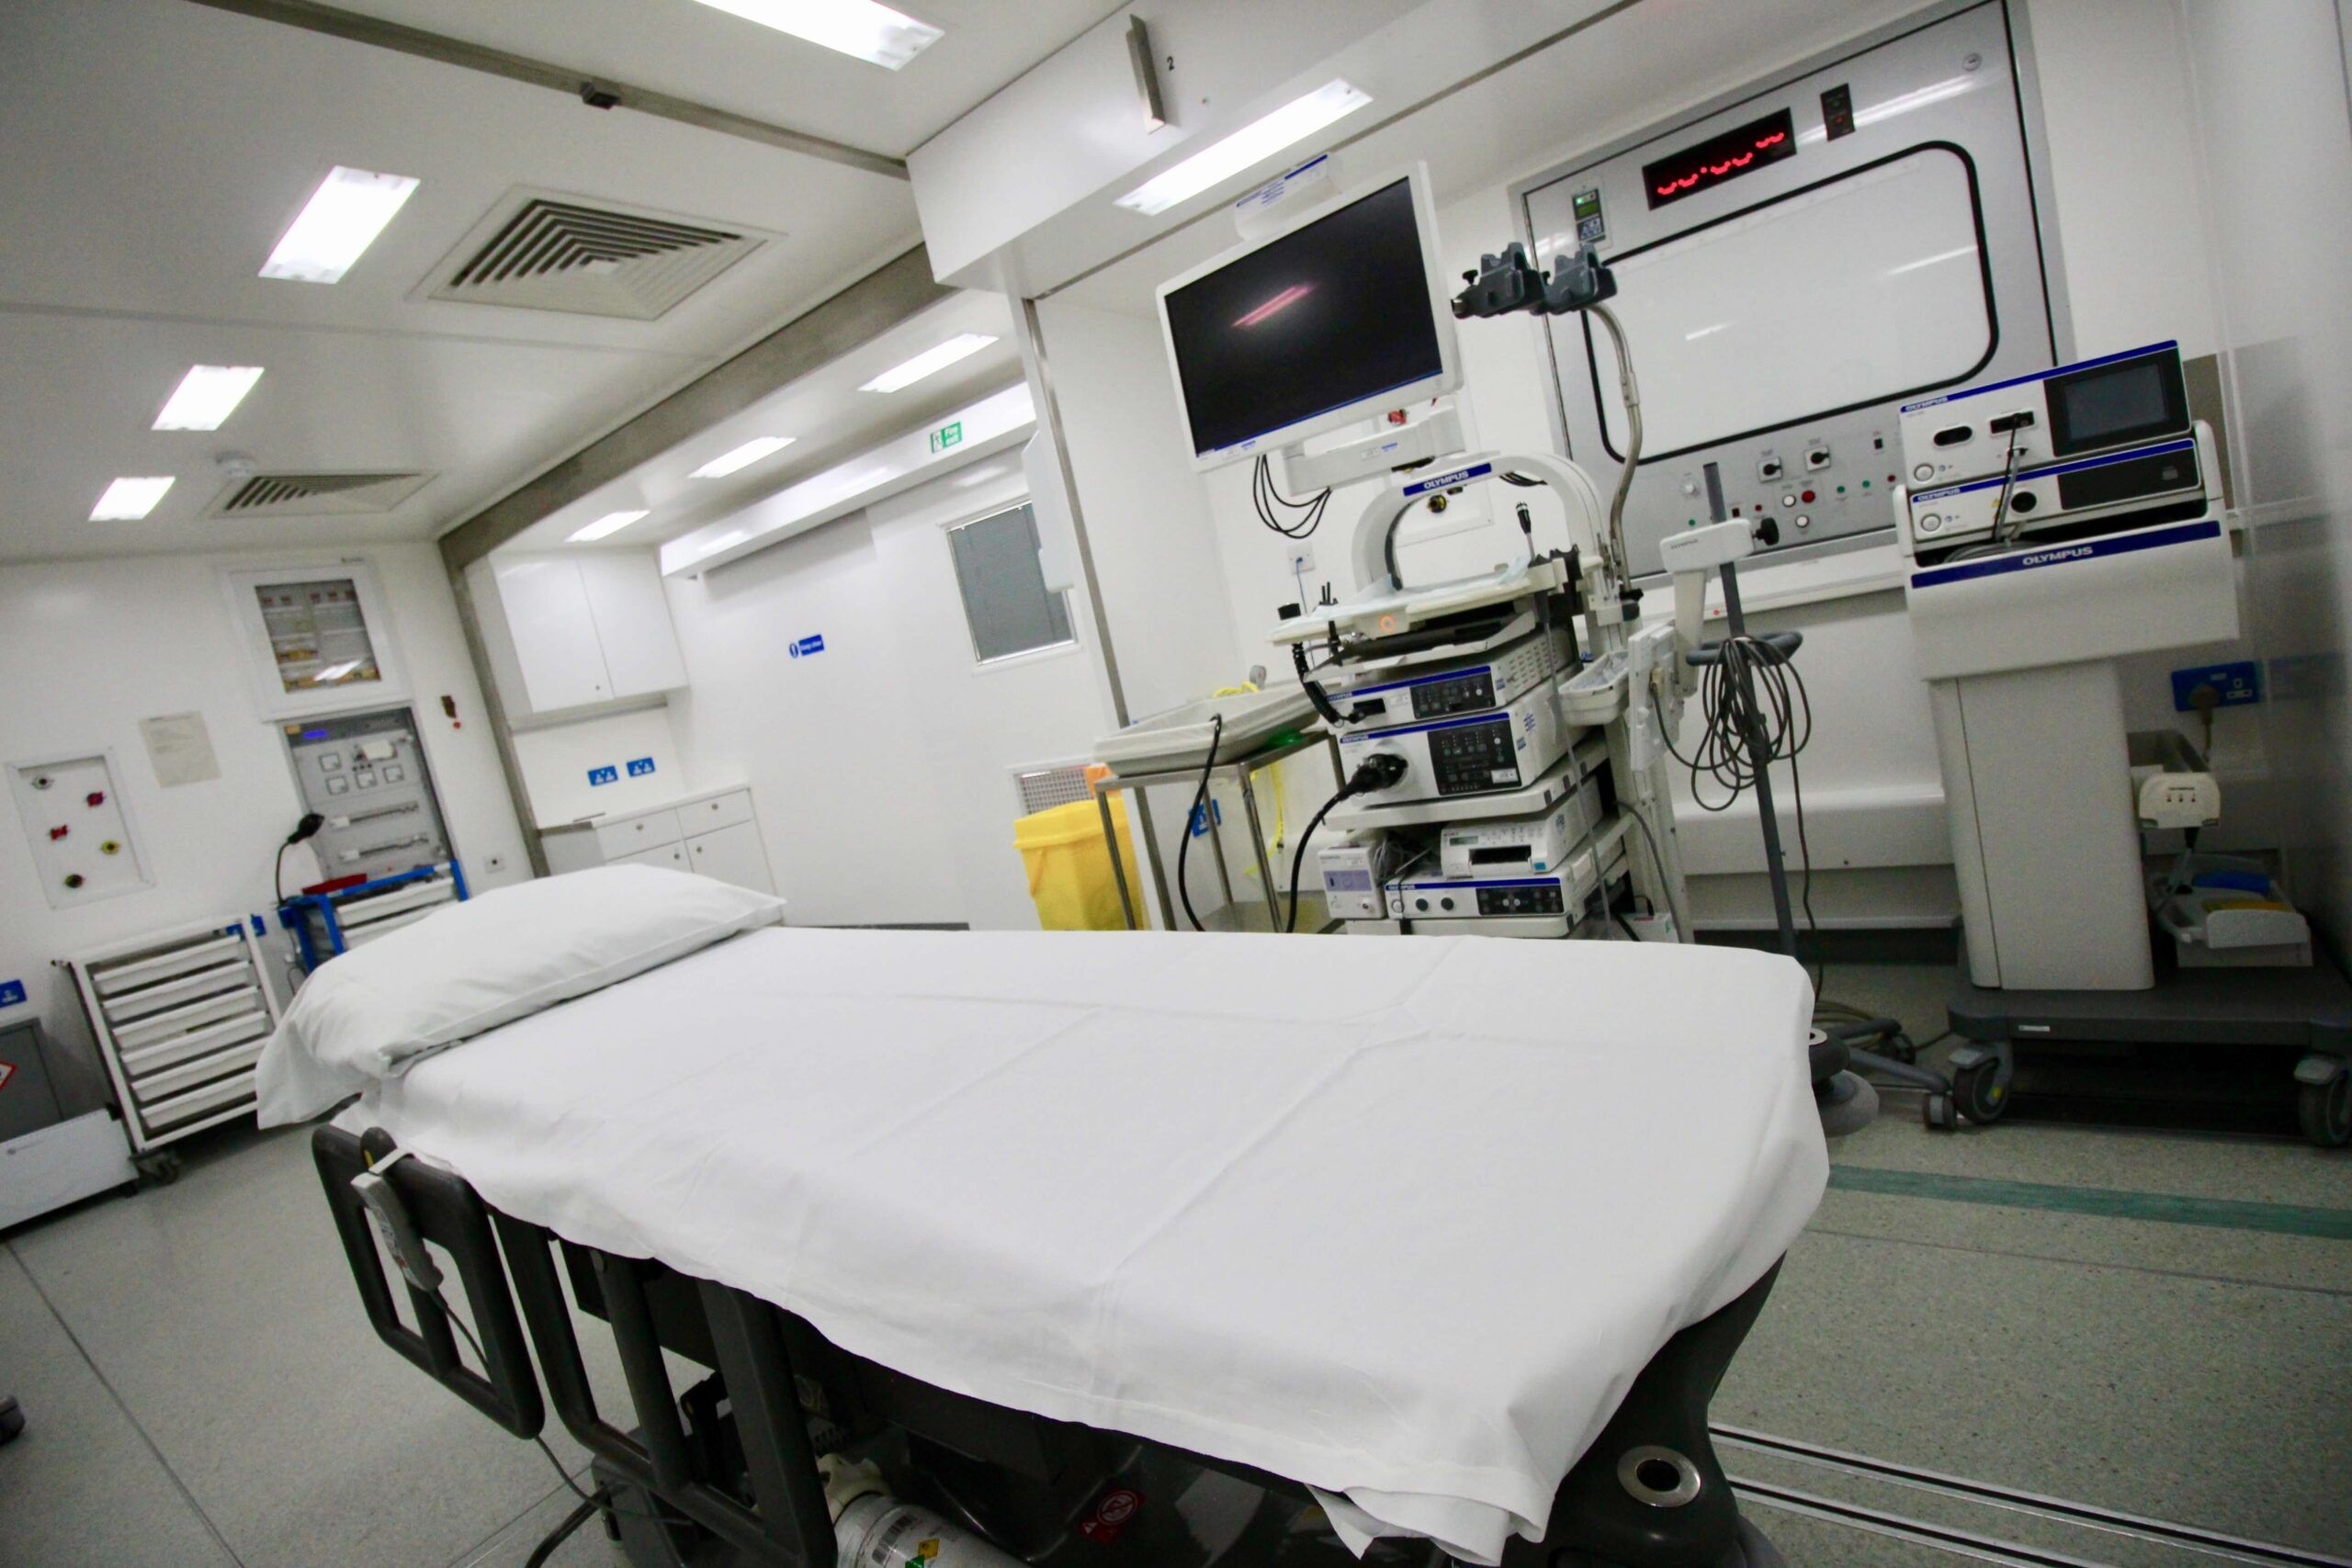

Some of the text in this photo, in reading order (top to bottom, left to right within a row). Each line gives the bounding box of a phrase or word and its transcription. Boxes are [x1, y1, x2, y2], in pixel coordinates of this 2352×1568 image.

[1167, 56, 1175, 72] 2
[1905, 396, 1948, 412] OLYMPUS
[1423, 470, 1469, 490] OLYMPUS
[1917, 488, 1961, 502] OLYMPUS
[2022, 547, 2093, 565] OLYMPUS
